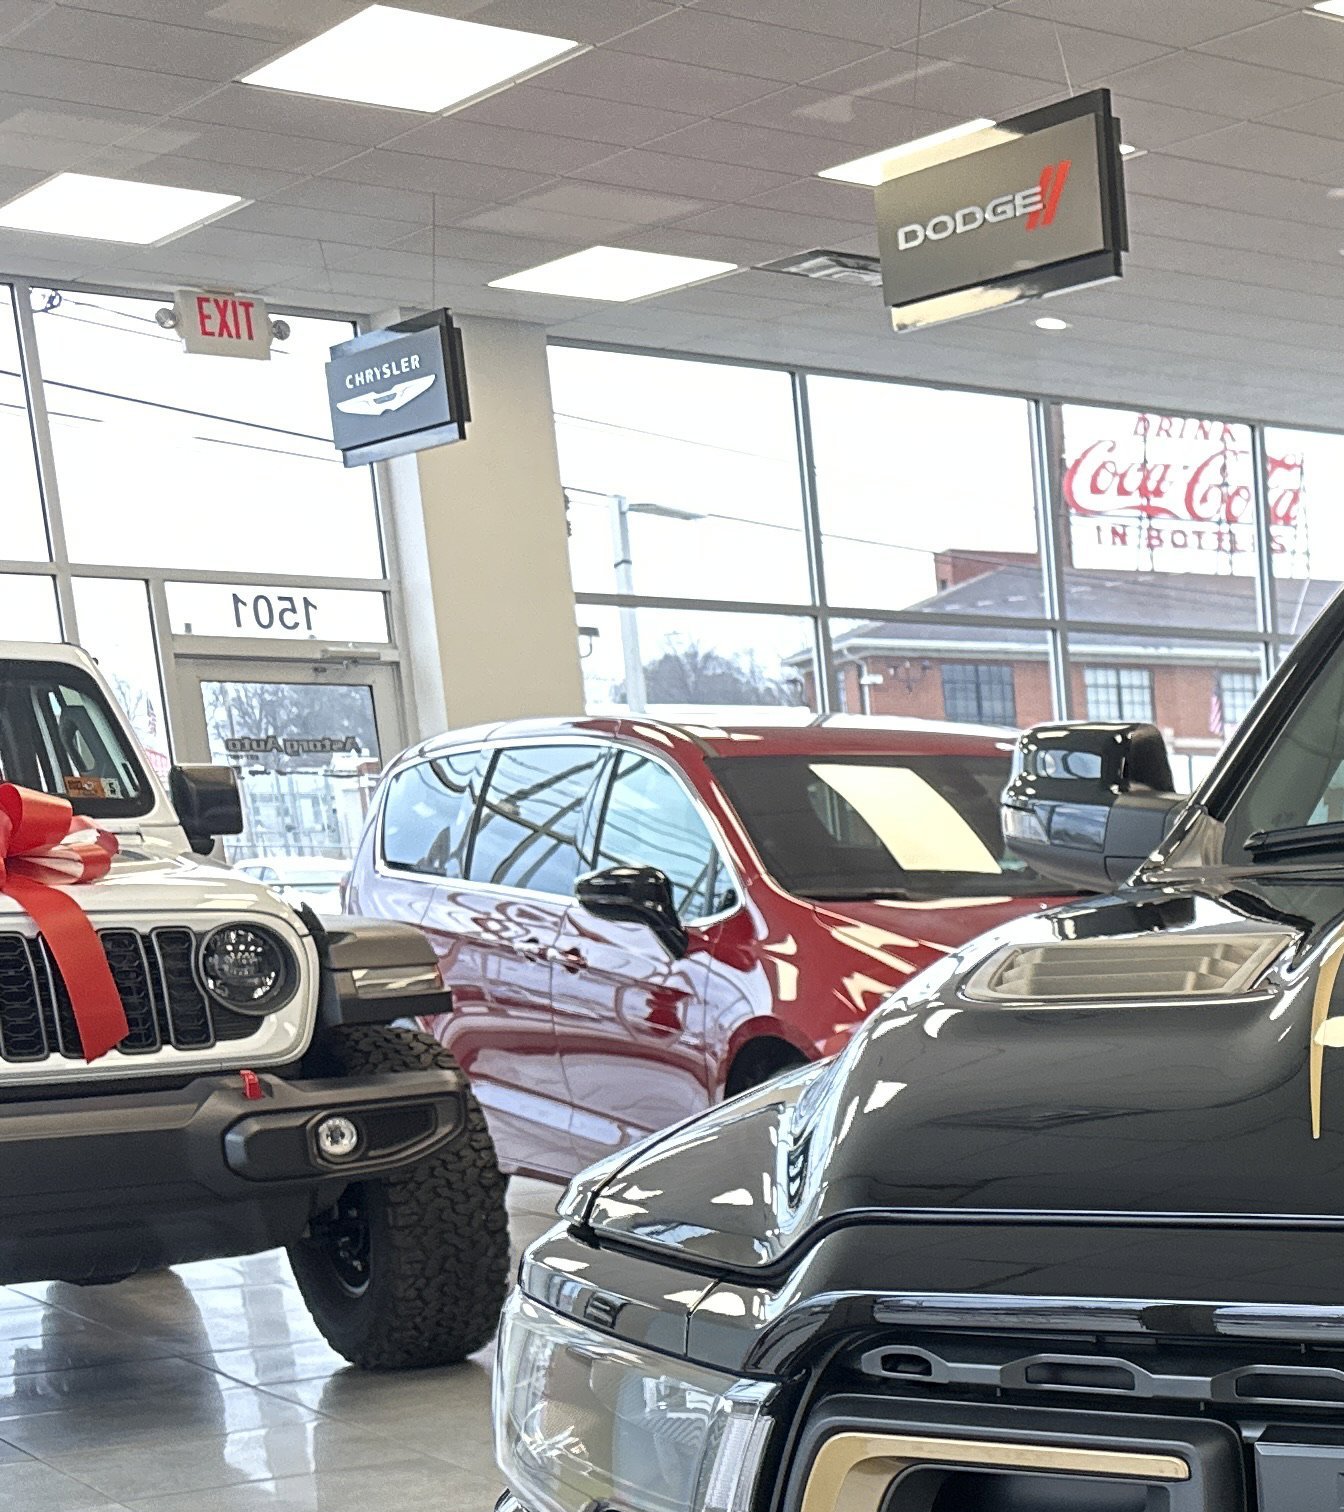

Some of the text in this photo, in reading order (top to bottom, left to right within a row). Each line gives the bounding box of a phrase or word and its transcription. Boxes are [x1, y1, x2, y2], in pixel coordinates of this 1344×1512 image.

[896, 184, 1044, 251] DODGE
[196, 296, 255, 341] EXIT
[345, 354, 421, 389] CHRYSLER
[1133, 412, 1236, 442] DRINK
[1063, 439, 1303, 524] Coca-Coa
[1096, 524, 1287, 554] IN BOTTLS
